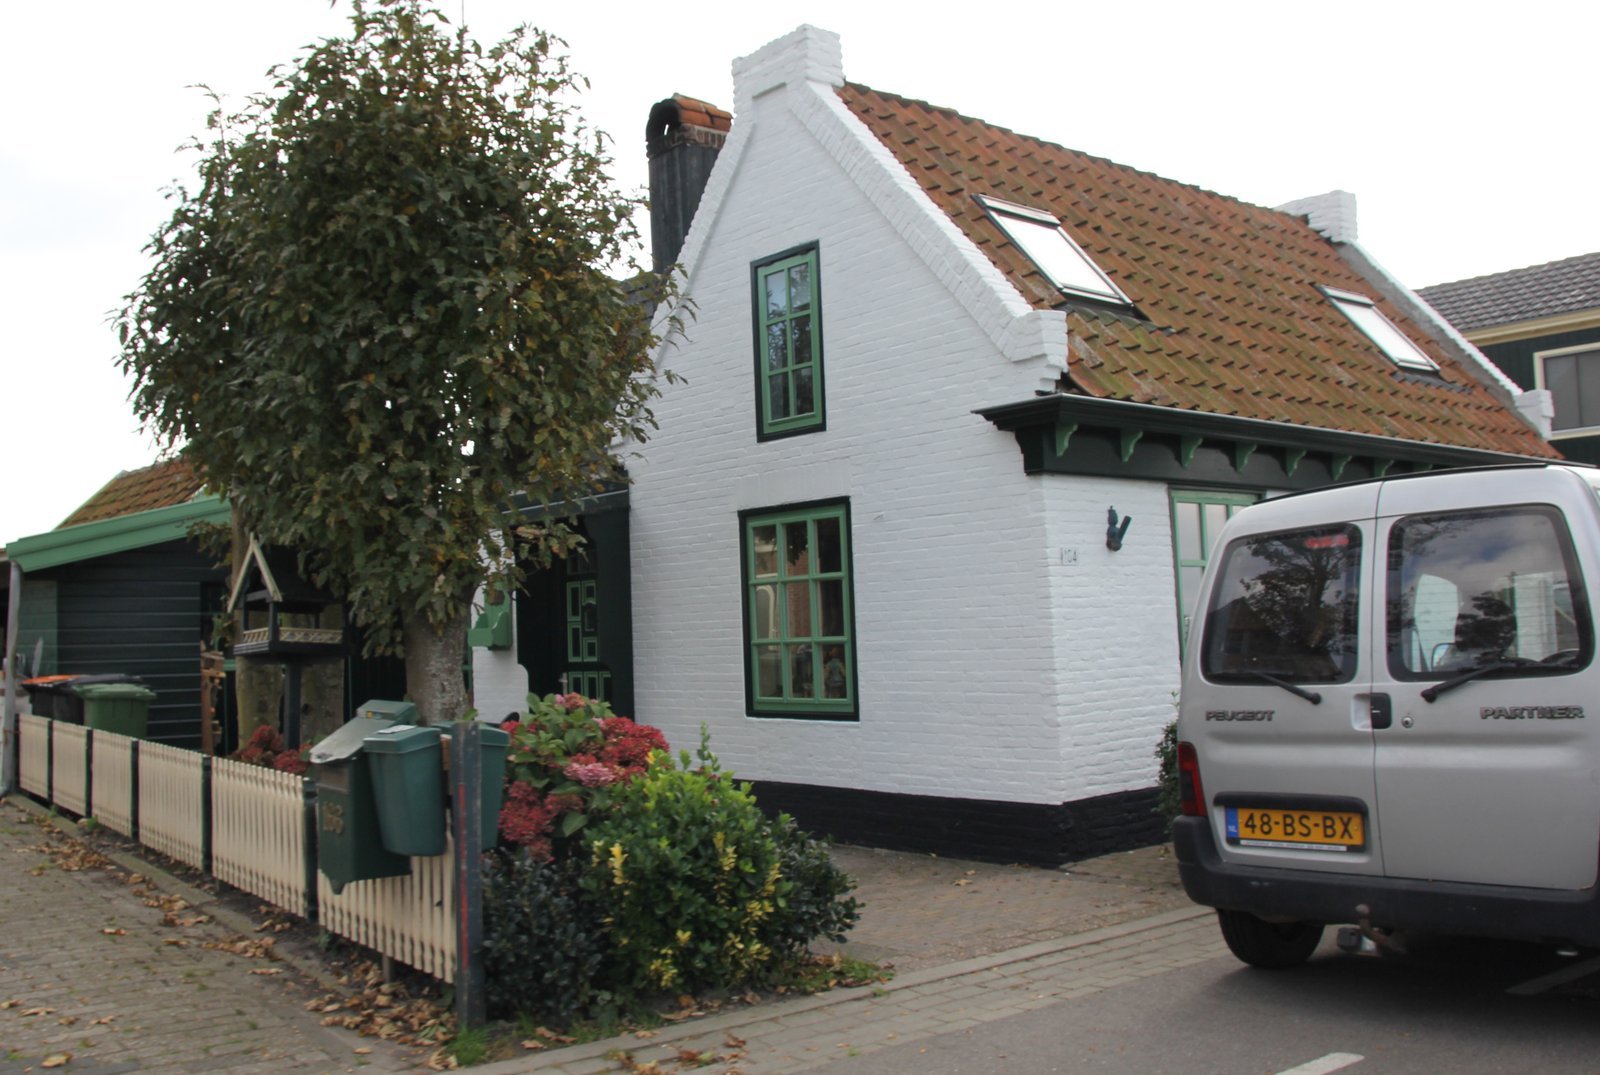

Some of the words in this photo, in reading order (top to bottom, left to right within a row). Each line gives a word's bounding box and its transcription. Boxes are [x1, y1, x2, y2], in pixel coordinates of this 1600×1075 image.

[1205, 710, 1275, 722] PEUGEOT
[1480, 704, 1585, 720] PARTNER
[1244, 812, 1354, 840] 48-BS-BX
